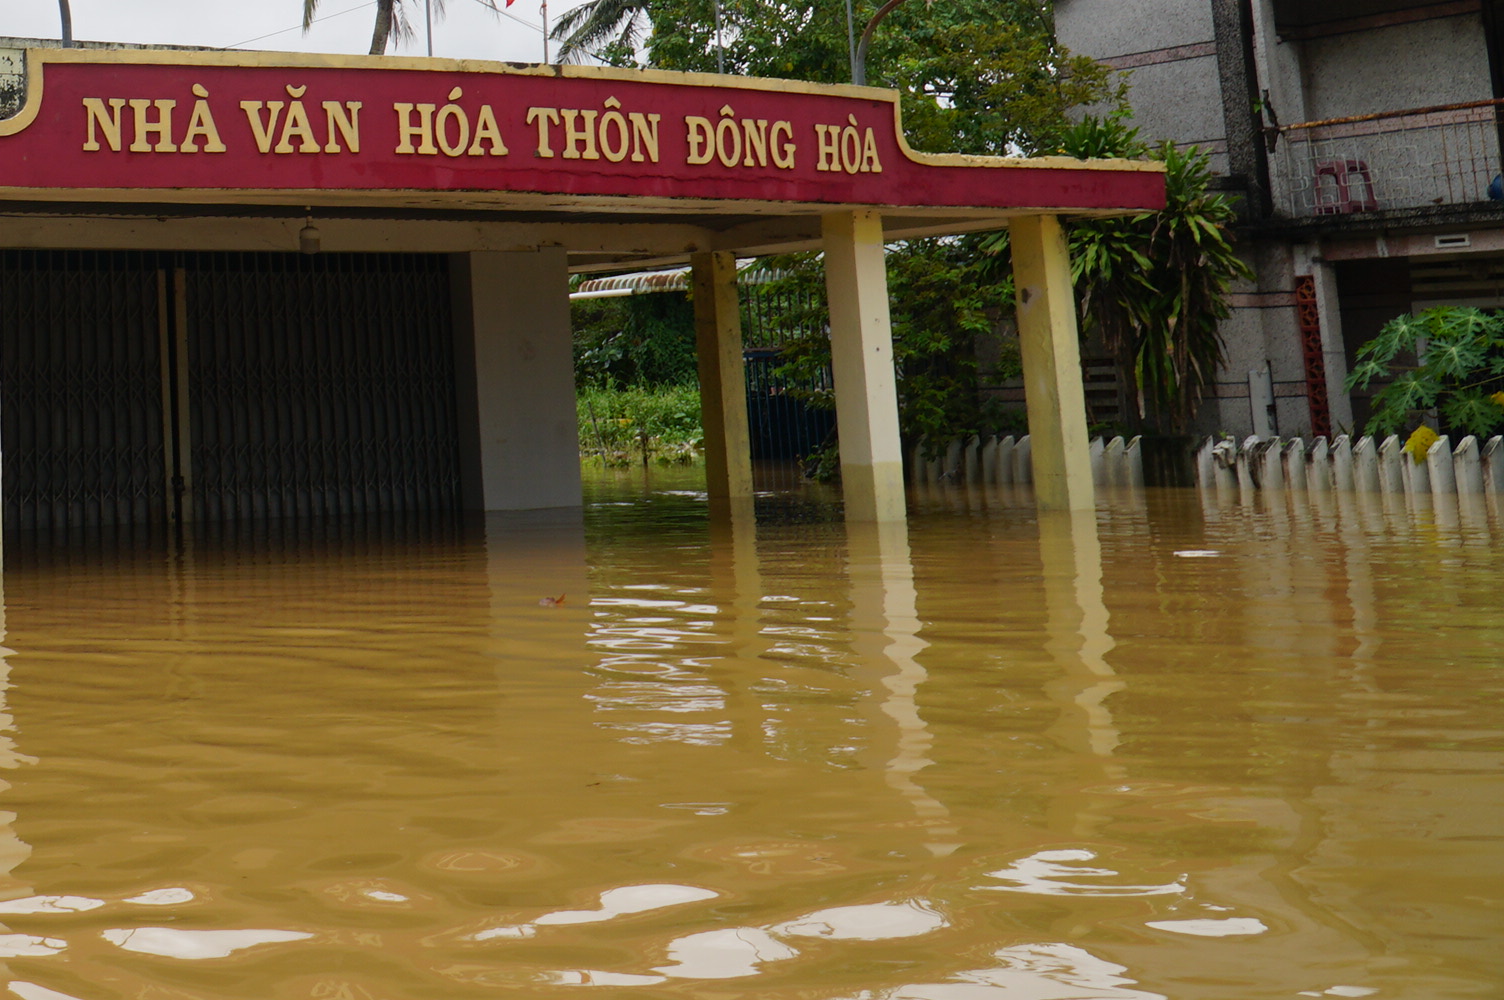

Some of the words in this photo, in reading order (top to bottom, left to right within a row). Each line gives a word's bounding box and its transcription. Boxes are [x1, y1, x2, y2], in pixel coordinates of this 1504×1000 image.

[82, 83, 226, 153] NHÀ
[240, 84, 362, 153] VĂN
[394, 86, 508, 157] HÓA
[526, 95, 661, 163] THÔN
[685, 104, 796, 169] ĐÔNG
[815, 113, 883, 174] HÒA
